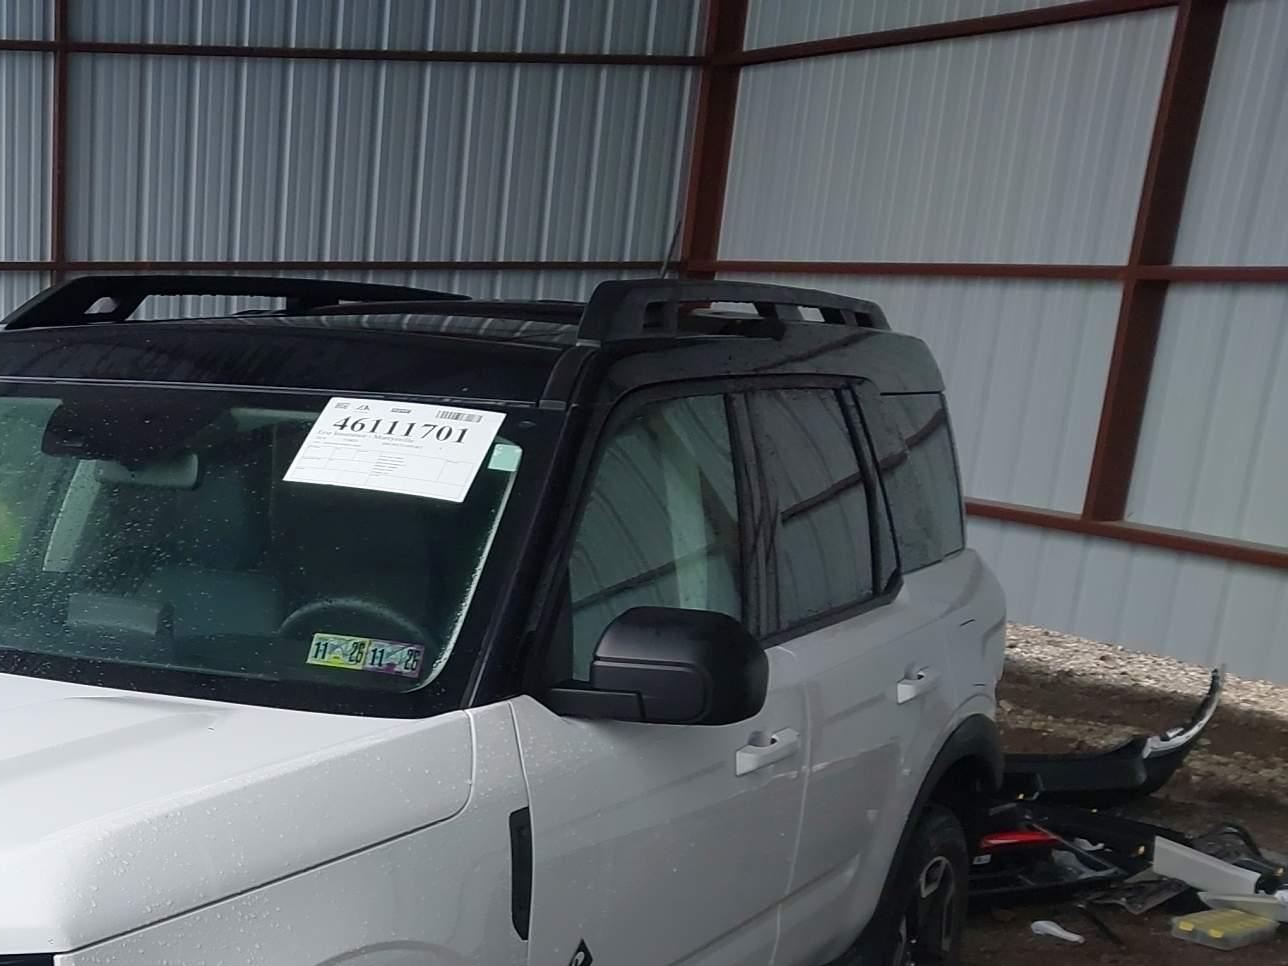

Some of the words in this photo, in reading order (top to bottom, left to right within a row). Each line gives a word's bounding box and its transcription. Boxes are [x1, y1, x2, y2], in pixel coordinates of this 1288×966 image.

[332, 416, 470, 444] 46111701
[314, 642, 328, 659] 11
[349, 642, 365, 663] 26
[370, 648, 385, 667] 11
